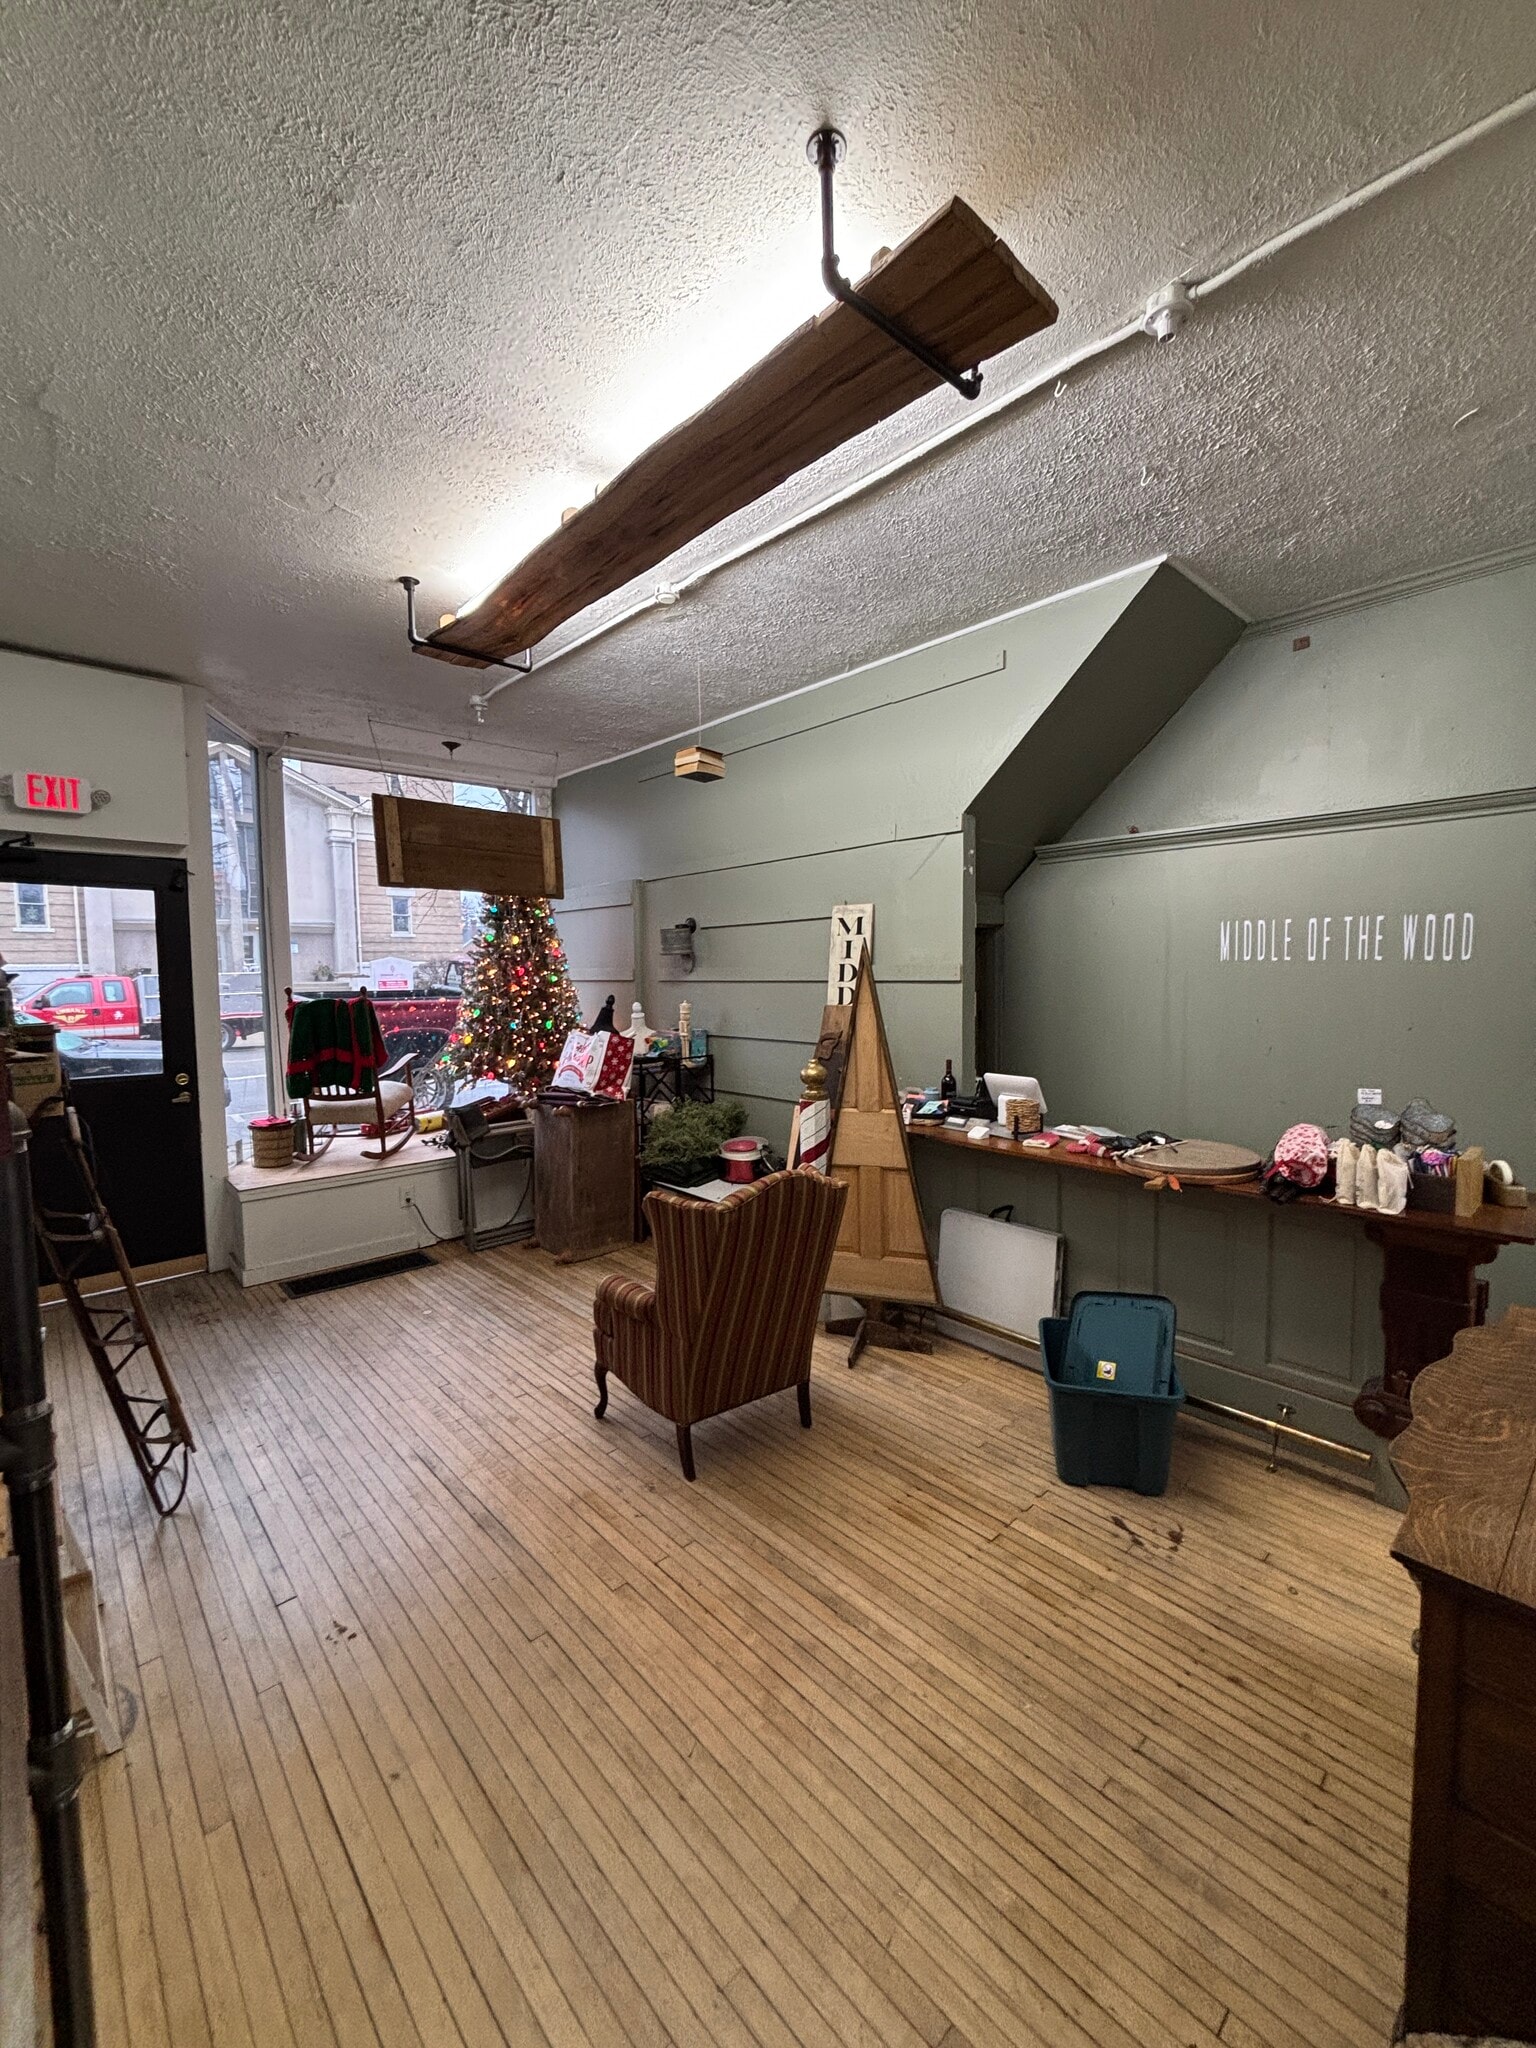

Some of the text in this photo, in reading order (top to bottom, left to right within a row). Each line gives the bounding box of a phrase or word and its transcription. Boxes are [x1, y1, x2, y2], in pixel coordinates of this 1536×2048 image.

[27, 774, 80, 810] EXIT
[1220, 912, 1474, 961] MIDDLE OF THE WOOD
